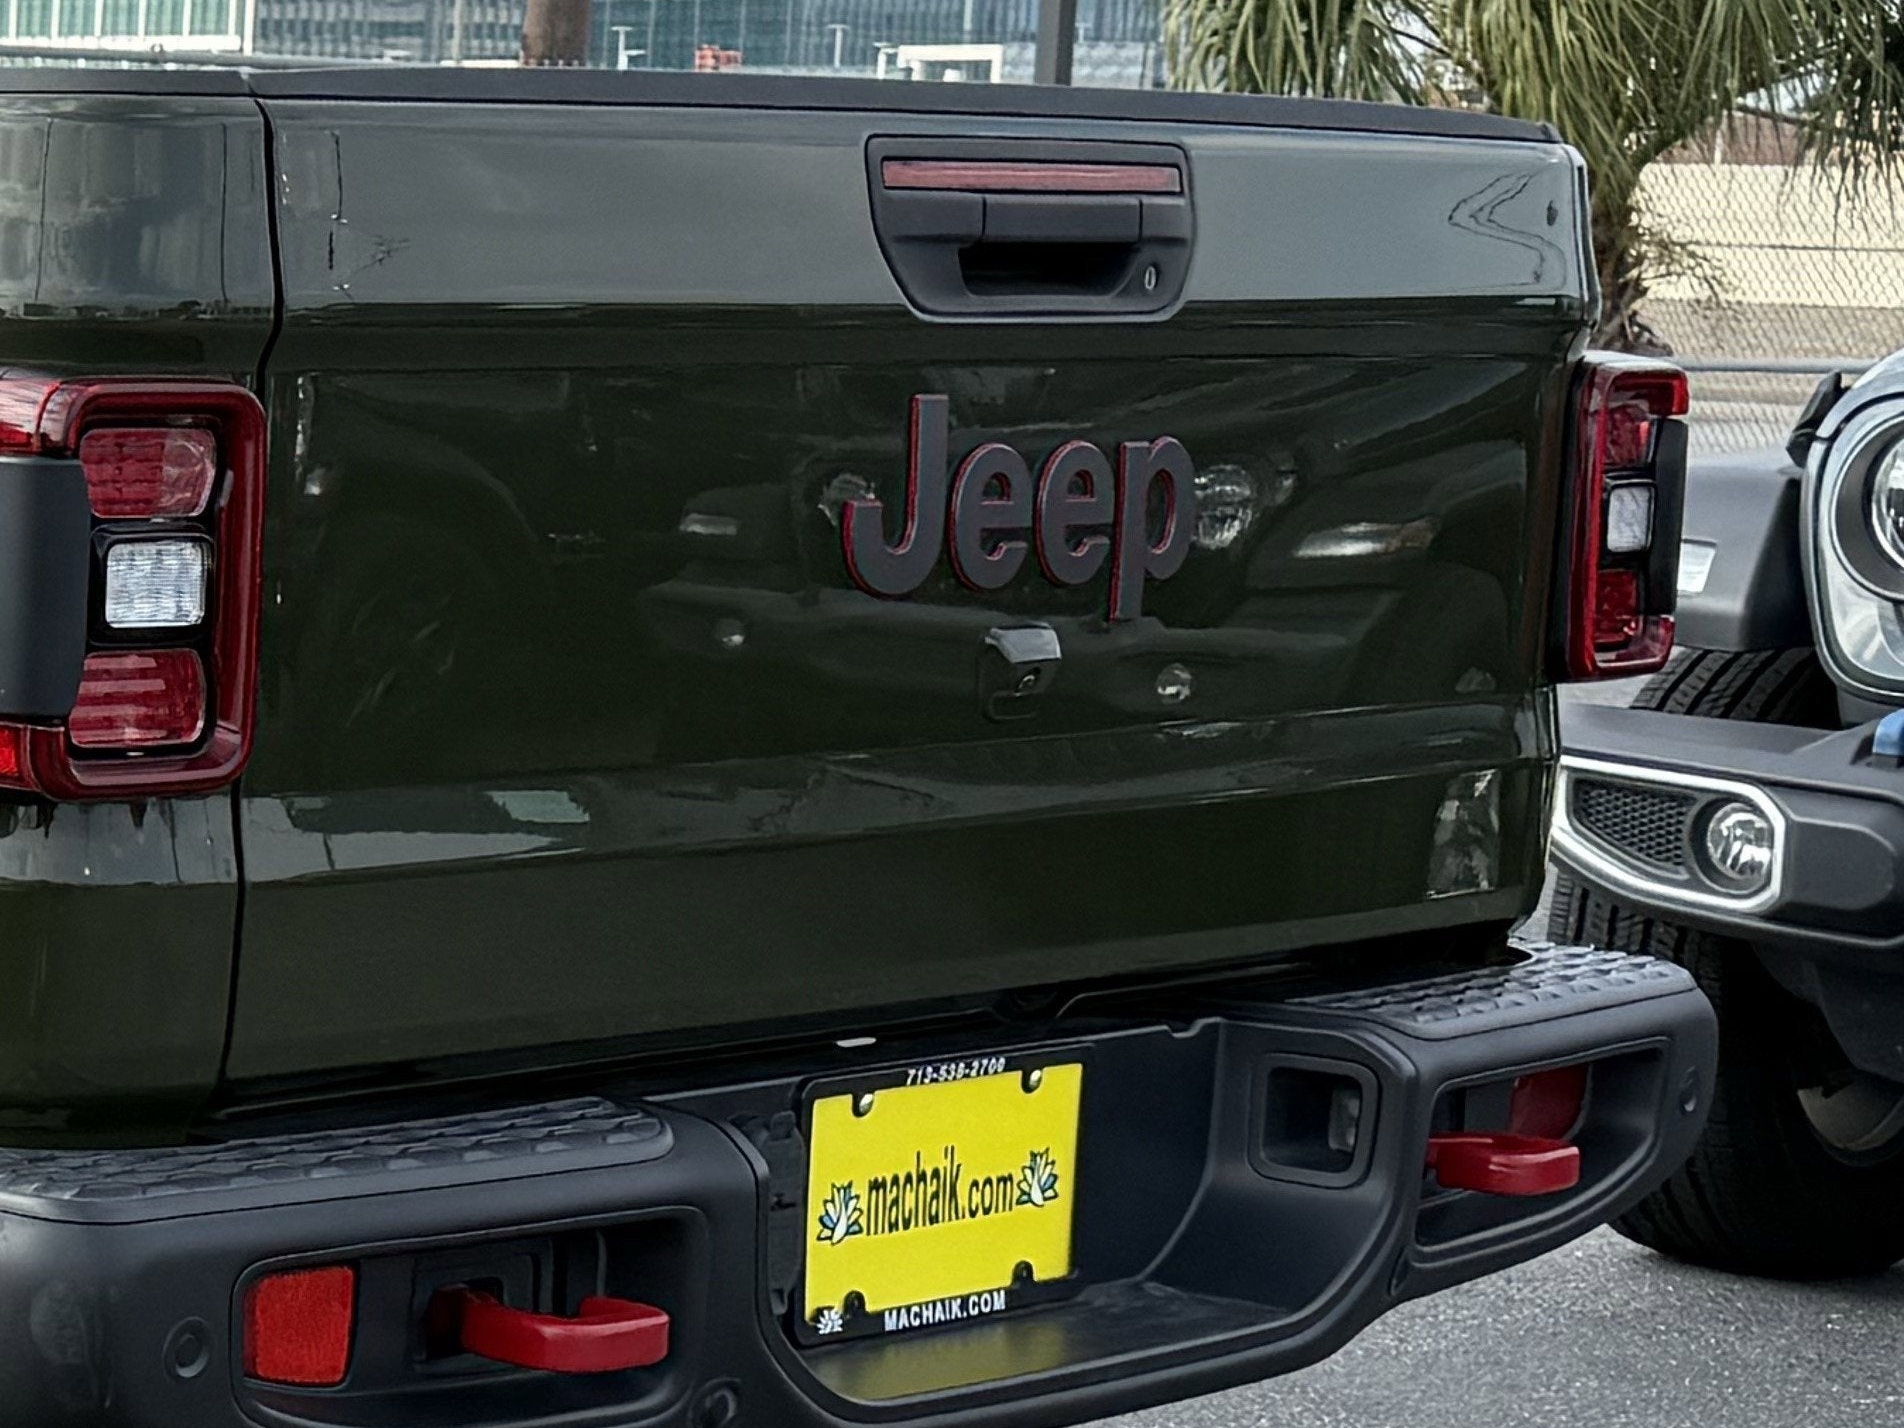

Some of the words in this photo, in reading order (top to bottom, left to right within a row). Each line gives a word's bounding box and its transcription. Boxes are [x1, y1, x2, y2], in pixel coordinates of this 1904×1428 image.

[841, 392, 1194, 623] Jeep
[865, 1145, 1014, 1237] machaik.com
[884, 1290, 1007, 1332] MACHAIK.COM
